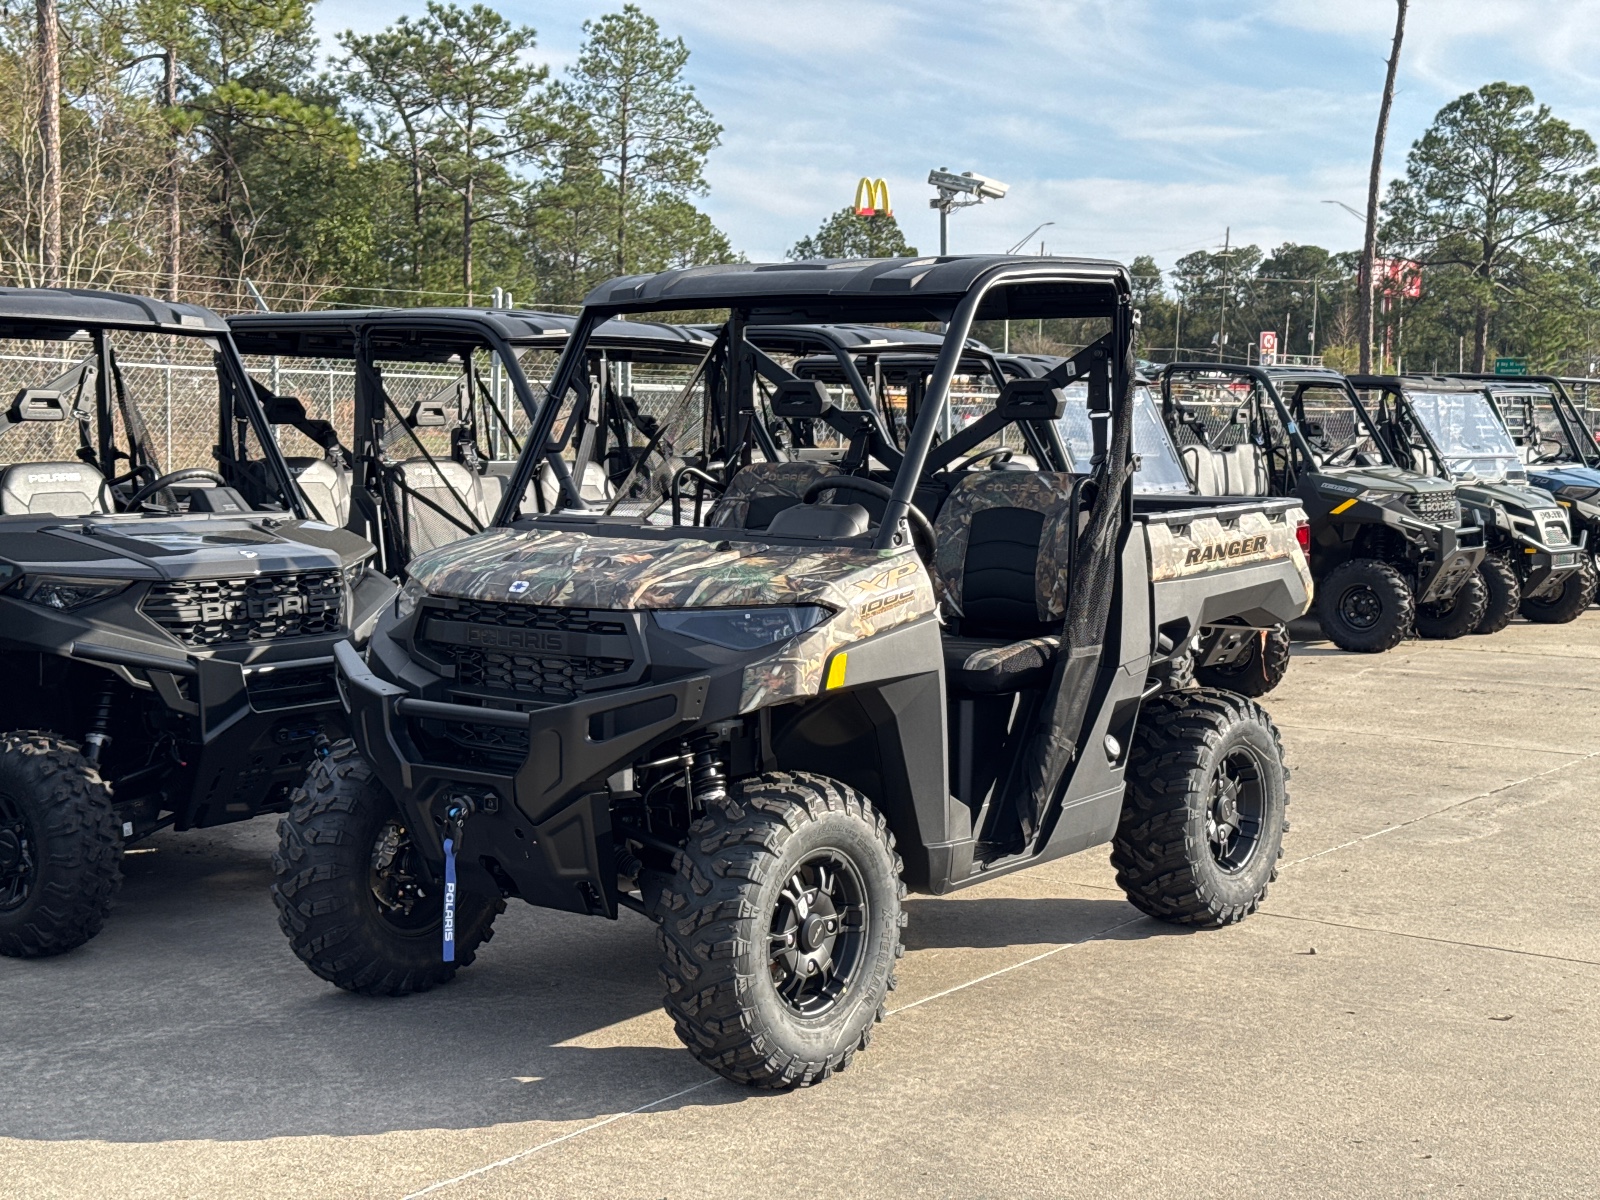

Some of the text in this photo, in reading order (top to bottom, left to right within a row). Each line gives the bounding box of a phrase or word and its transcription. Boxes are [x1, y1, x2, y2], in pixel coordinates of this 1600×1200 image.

[28, 473, 81, 483] POLARIS
[761, 473, 808, 482] POLARIS
[985, 483, 1040, 492] POLARIS
[1184, 534, 1268, 567] RANGER
[851, 561, 919, 599] XP
[202, 595, 328, 623] POLARIS
[861, 589, 915, 615] 1000
[467, 626, 563, 652] POLARIS
[444, 882, 455, 942] POLARIS
